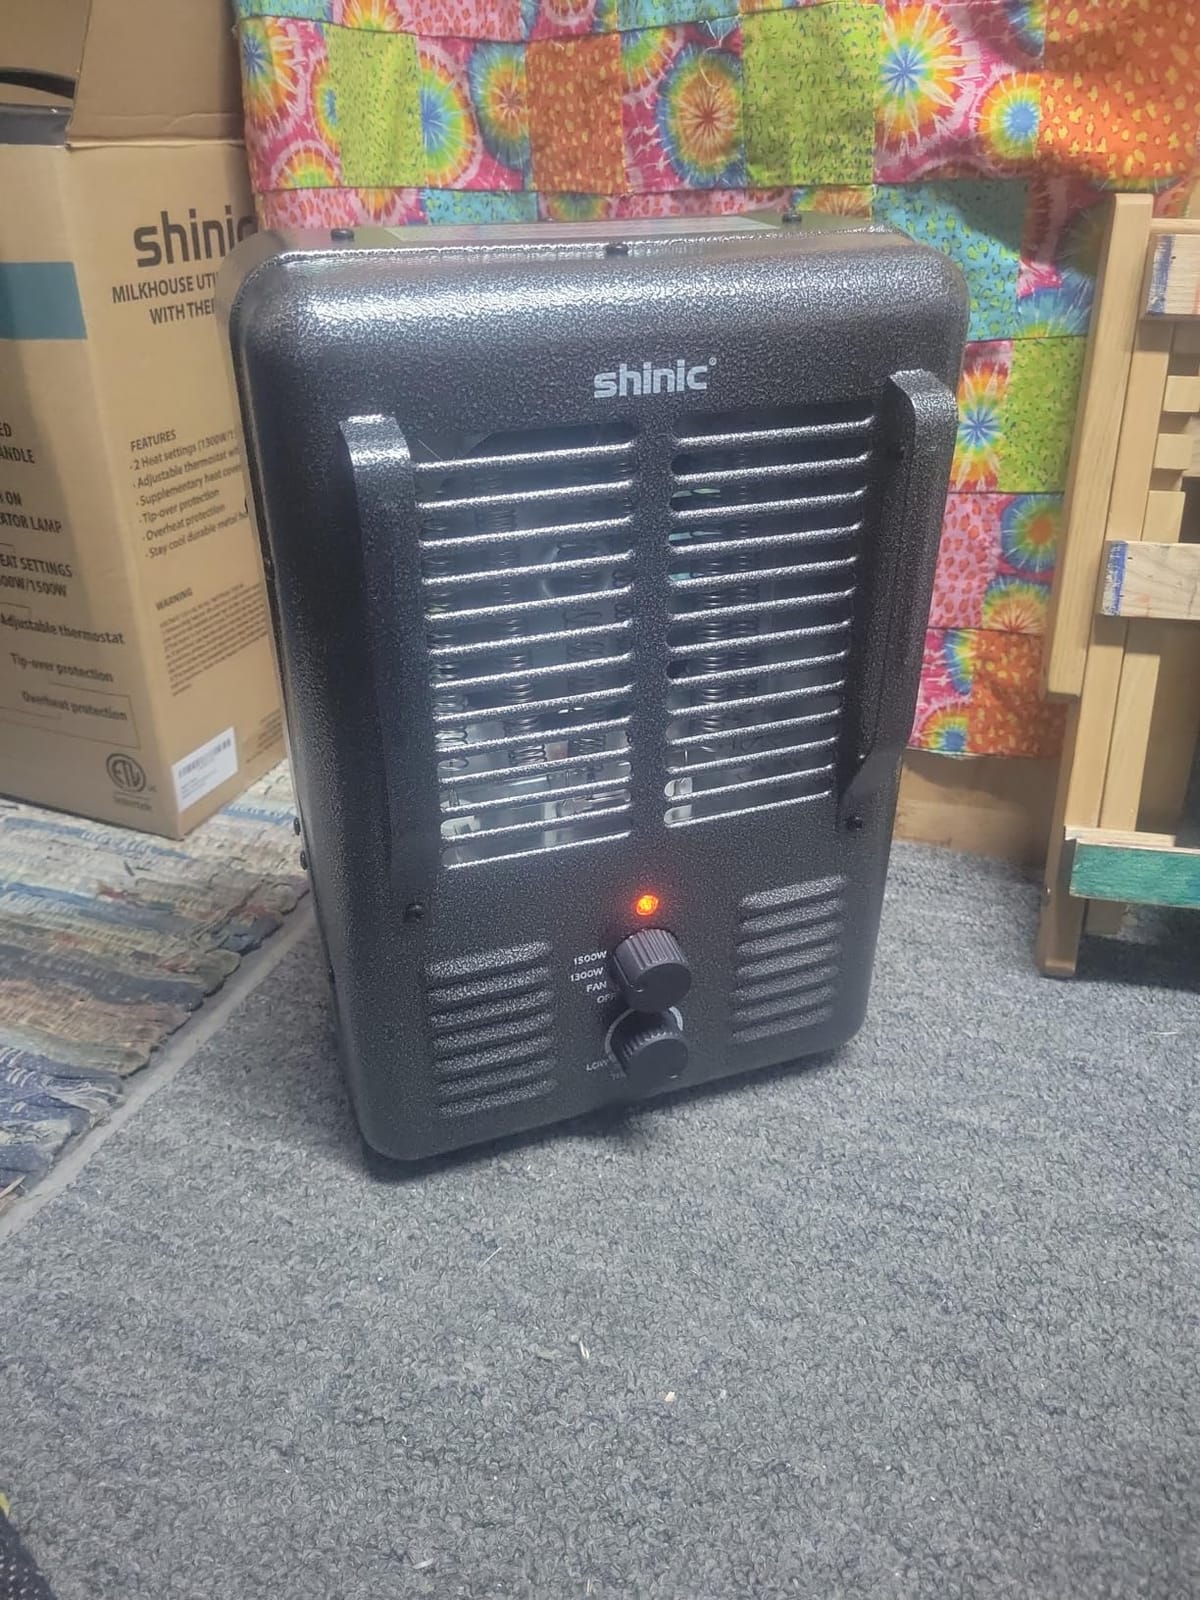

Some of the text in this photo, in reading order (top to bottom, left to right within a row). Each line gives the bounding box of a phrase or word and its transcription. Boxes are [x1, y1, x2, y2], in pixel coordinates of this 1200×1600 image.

[112, 276, 194, 304] MILKHOUSE
[149, 303, 186, 325] WITH
[130, 429, 177, 452] FEATURES
[142, 453, 163, 468] Heat
[164, 443, 197, 461] settings
[137, 465, 183, 488] Adjustable
[184, 451, 228, 473] thermostat
[140, 477, 203, 507] Supplementary
[142, 489, 220, 524] Tip-over protection
[30, 516, 62, 534] LAMP
[145, 504, 226, 541] Overheat protection
[169, 534, 187, 551] cool
[187, 524, 217, 543] durable
[20, 557, 73, 578] SETTINGS
[58, 624, 125, 645] thermostat
[573, 950, 608, 965] 1500W
[570, 967, 604, 982] 1300W
[586, 981, 607, 993] FAN
